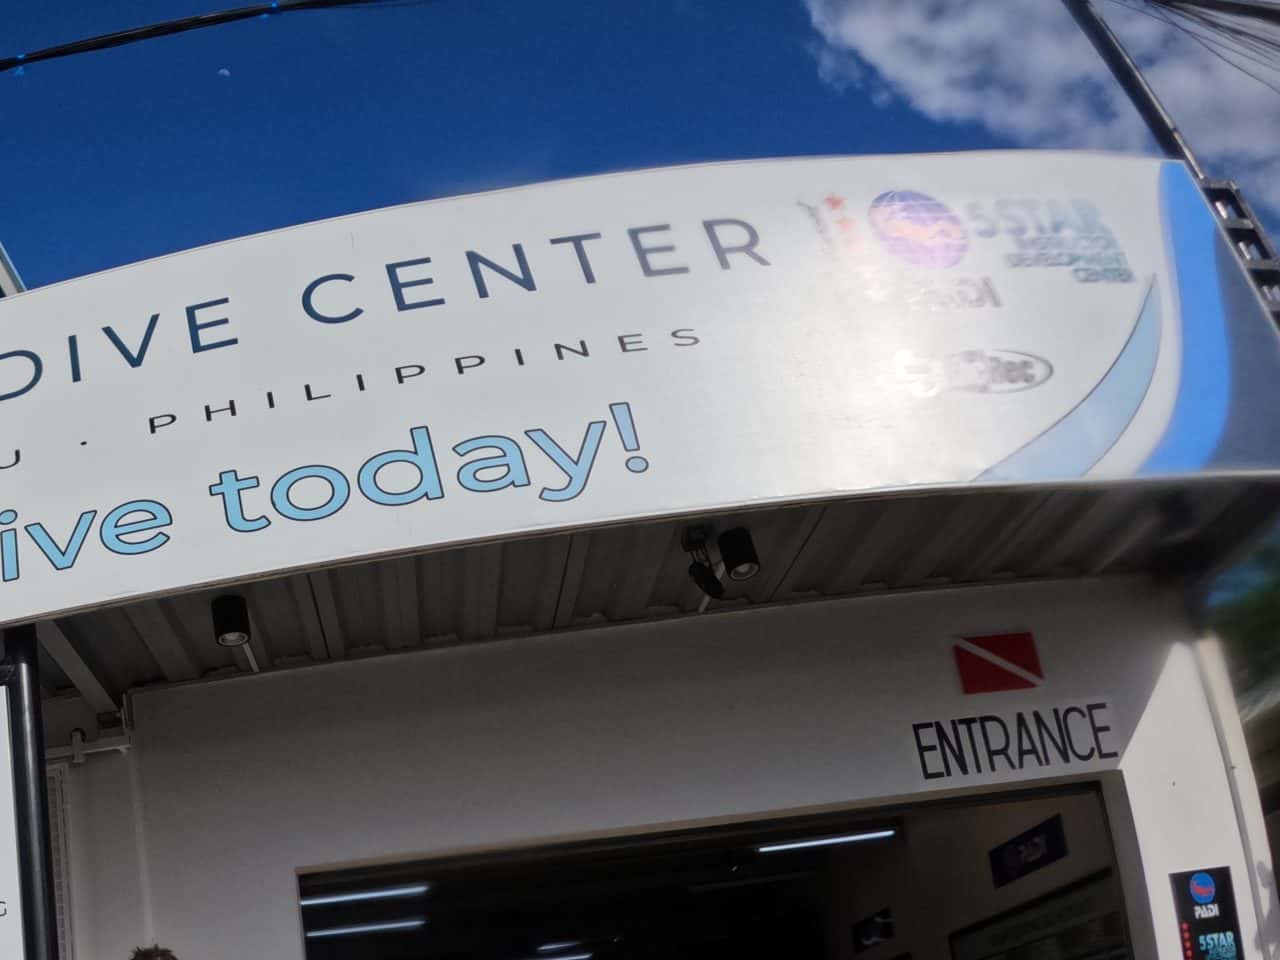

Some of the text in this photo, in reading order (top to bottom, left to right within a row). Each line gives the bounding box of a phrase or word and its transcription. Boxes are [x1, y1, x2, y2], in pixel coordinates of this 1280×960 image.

[301, 217, 772, 324] CENTER
[147, 328, 701, 434] PHILIPPINES
[209, 401, 650, 533] today!
[911, 702, 1119, 780] ENTRANCE
[1193, 903, 1220, 919] PADI
